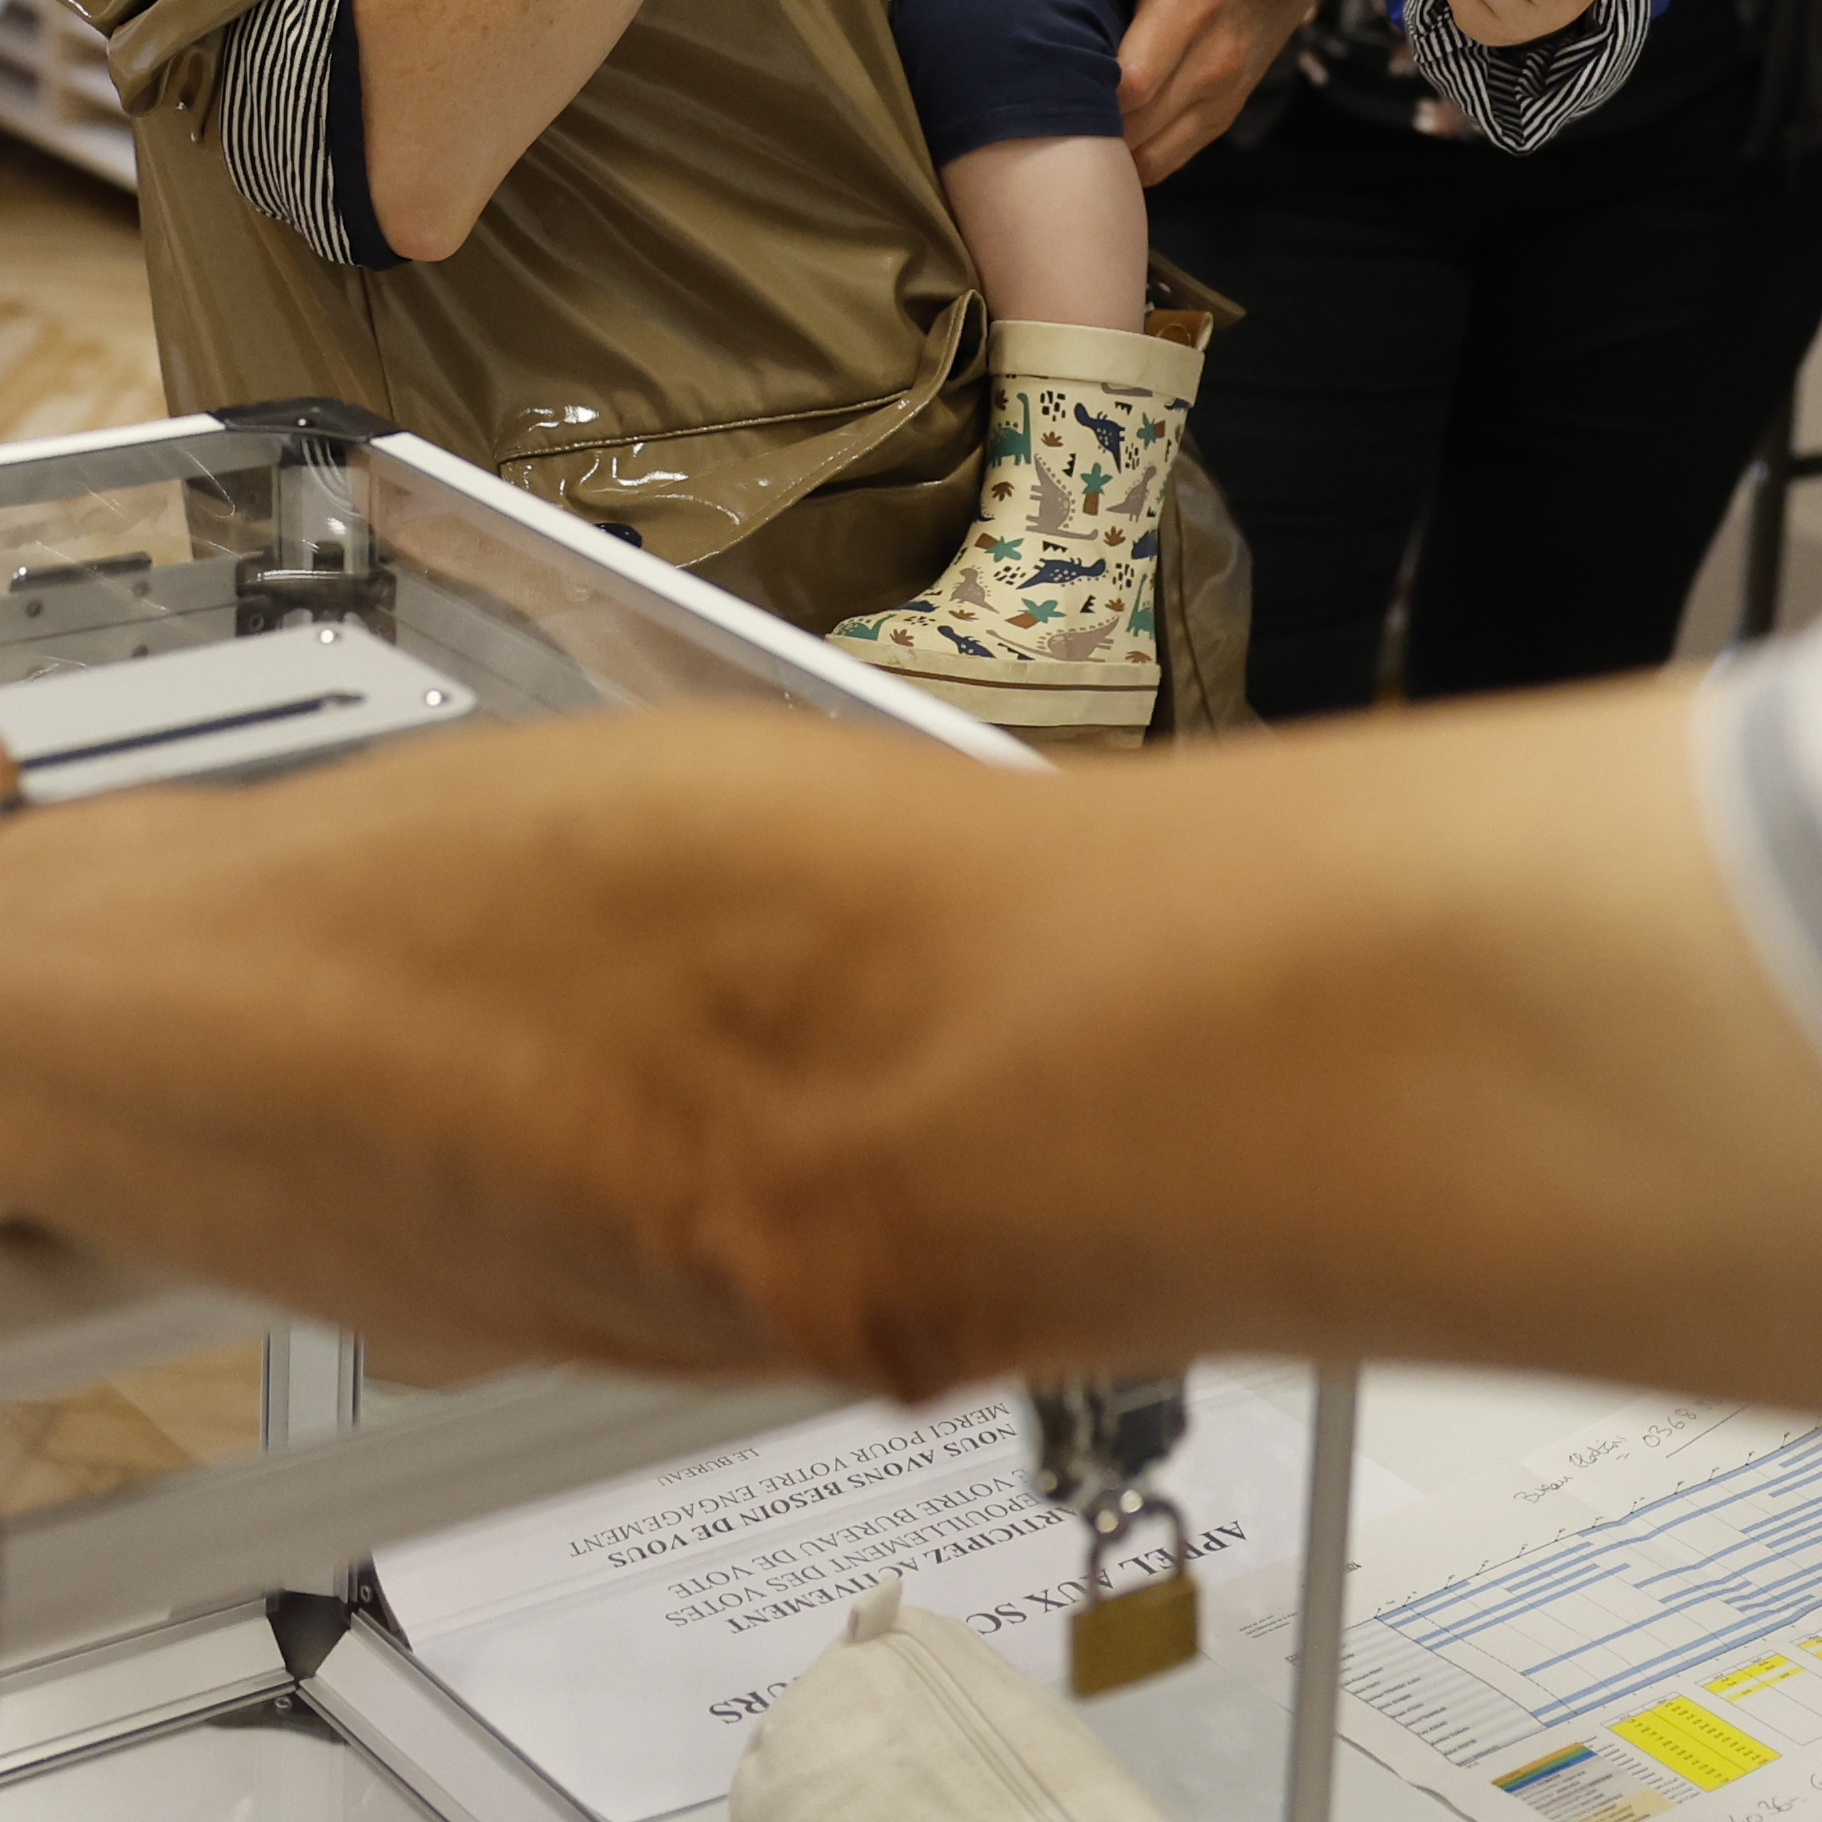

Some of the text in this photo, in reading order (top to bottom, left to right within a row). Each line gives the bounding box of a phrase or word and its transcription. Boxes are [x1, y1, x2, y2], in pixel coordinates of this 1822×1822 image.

[569, 1402, 1011, 1558] MERCI POUR VOTRE ENGAGEMENT
[658, 1448, 760, 1487] LE BUREAU
[607, 1423, 1018, 1568] NOUS AVONS BESOIN DE VOUS
[916, 1477, 1016, 1517] VOTRE
[799, 1507, 920, 1557] BUREAU
[665, 1491, 1042, 1628] EPOUILLEMENT DES VOTES
[667, 1564, 757, 1600] VOTE
[752, 1549, 799, 1572] DE
[725, 1557, 920, 1635] ACTIVEMENT
